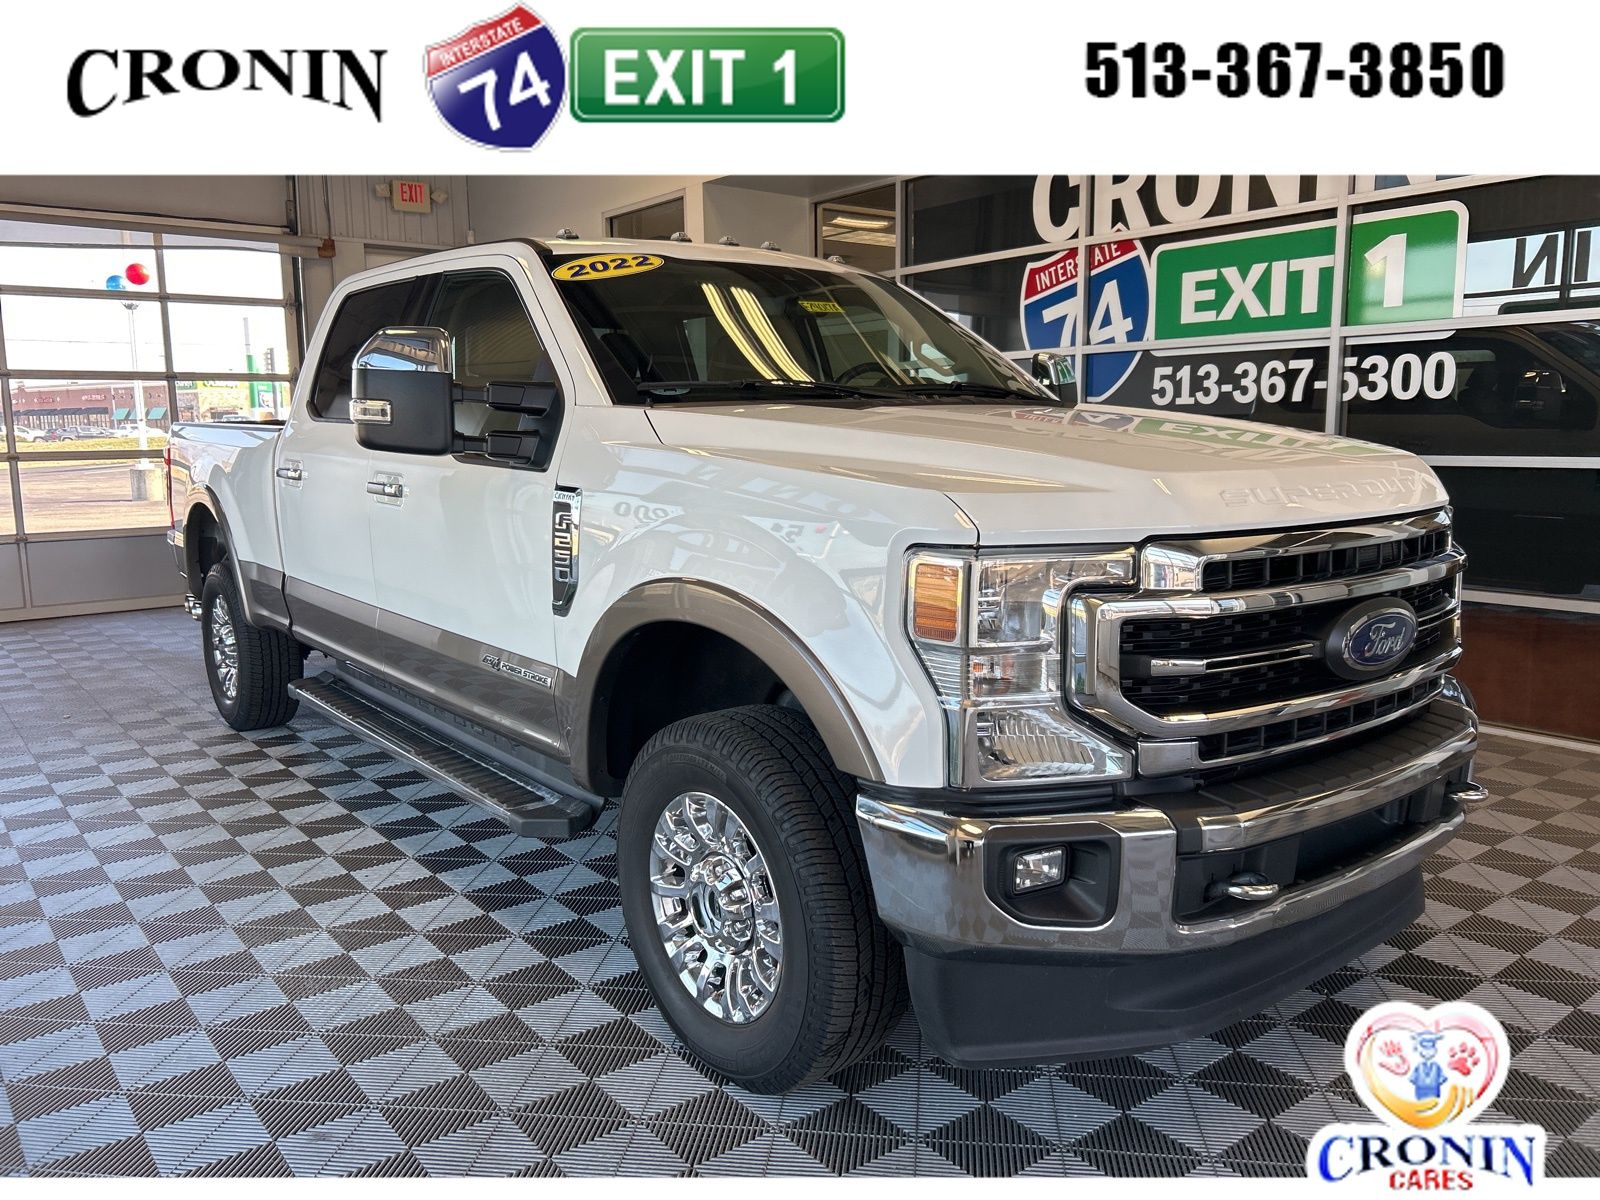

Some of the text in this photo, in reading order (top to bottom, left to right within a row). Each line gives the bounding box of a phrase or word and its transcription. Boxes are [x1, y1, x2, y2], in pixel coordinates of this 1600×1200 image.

[400, 182, 425, 203] EXIT
[567, 255, 655, 279] 2022
[1035, 242, 1122, 293] INTERATE
[1180, 233, 1407, 324] EXIT 1
[1042, 279, 1134, 347] 74
[1151, 351, 1457, 406] 513-367-5300
[1364, 621, 1407, 657] Ford
[501, 662, 523, 676] POWER
[523, 670, 549, 685] STROKE
